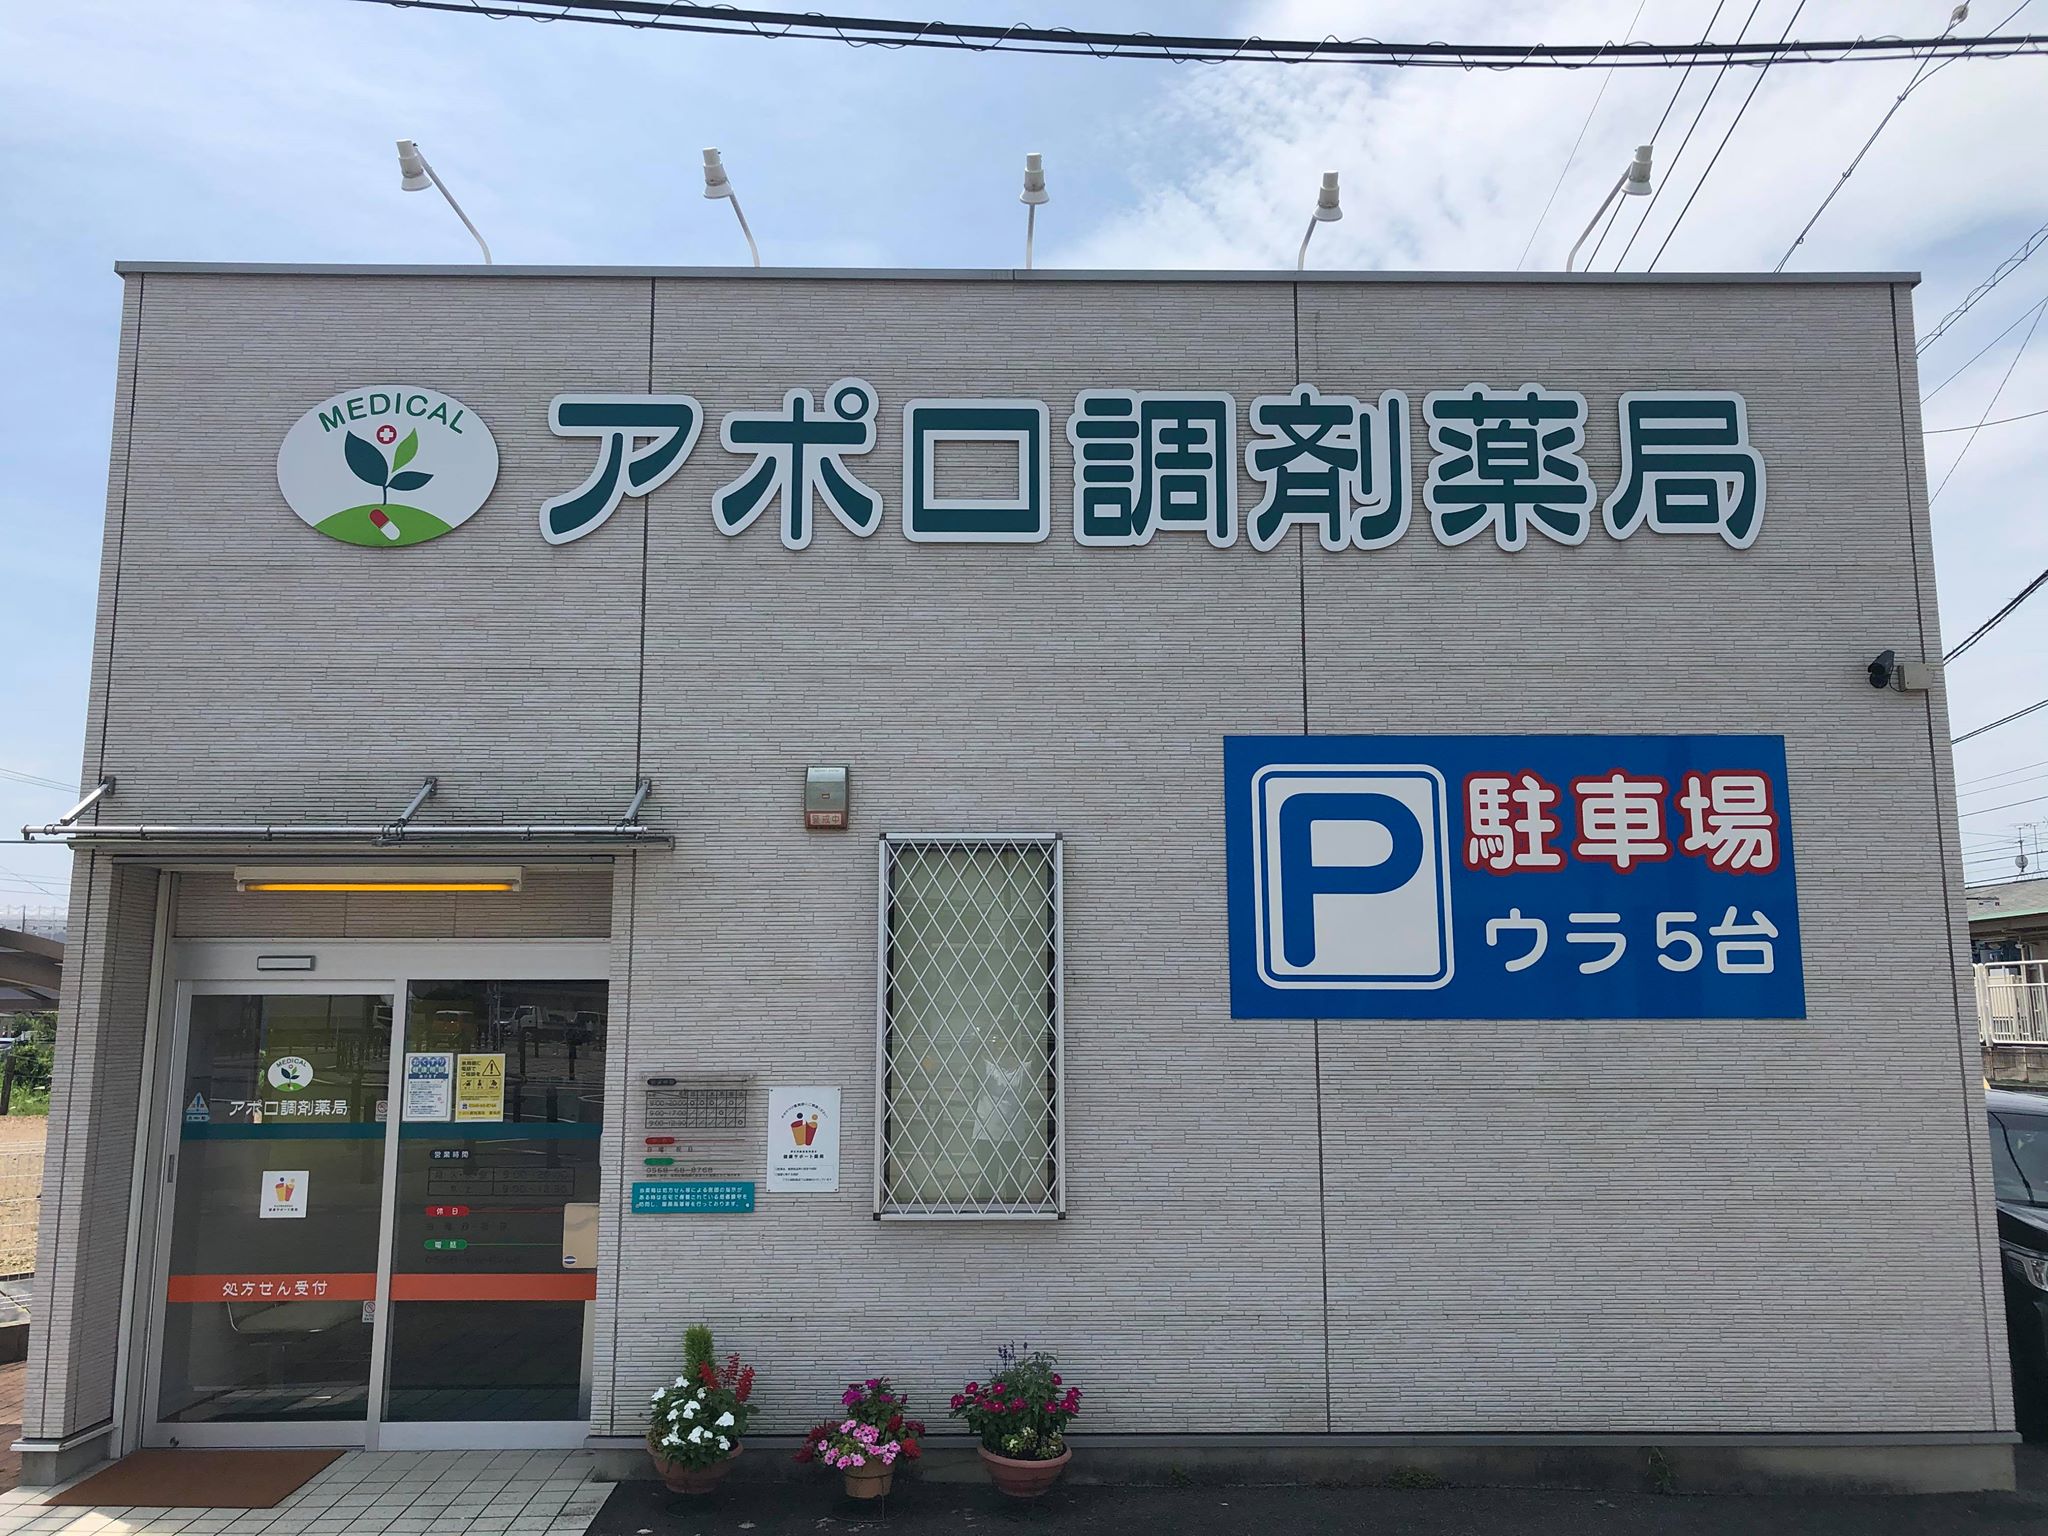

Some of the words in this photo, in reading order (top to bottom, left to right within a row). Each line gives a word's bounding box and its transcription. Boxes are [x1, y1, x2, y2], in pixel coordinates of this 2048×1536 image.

[318, 392, 464, 435] MEDICAL
[541, 379, 1765, 549] アポロ調剤薬局
[1466, 770, 1778, 873] 駐車場
[1279, 793, 1424, 968] P
[229, 1099, 348, 1117] アポロ調剤薬局
[434, 1150, 469, 1159] 営業時間
[222, 1280, 328, 1297] 処方せん受付
